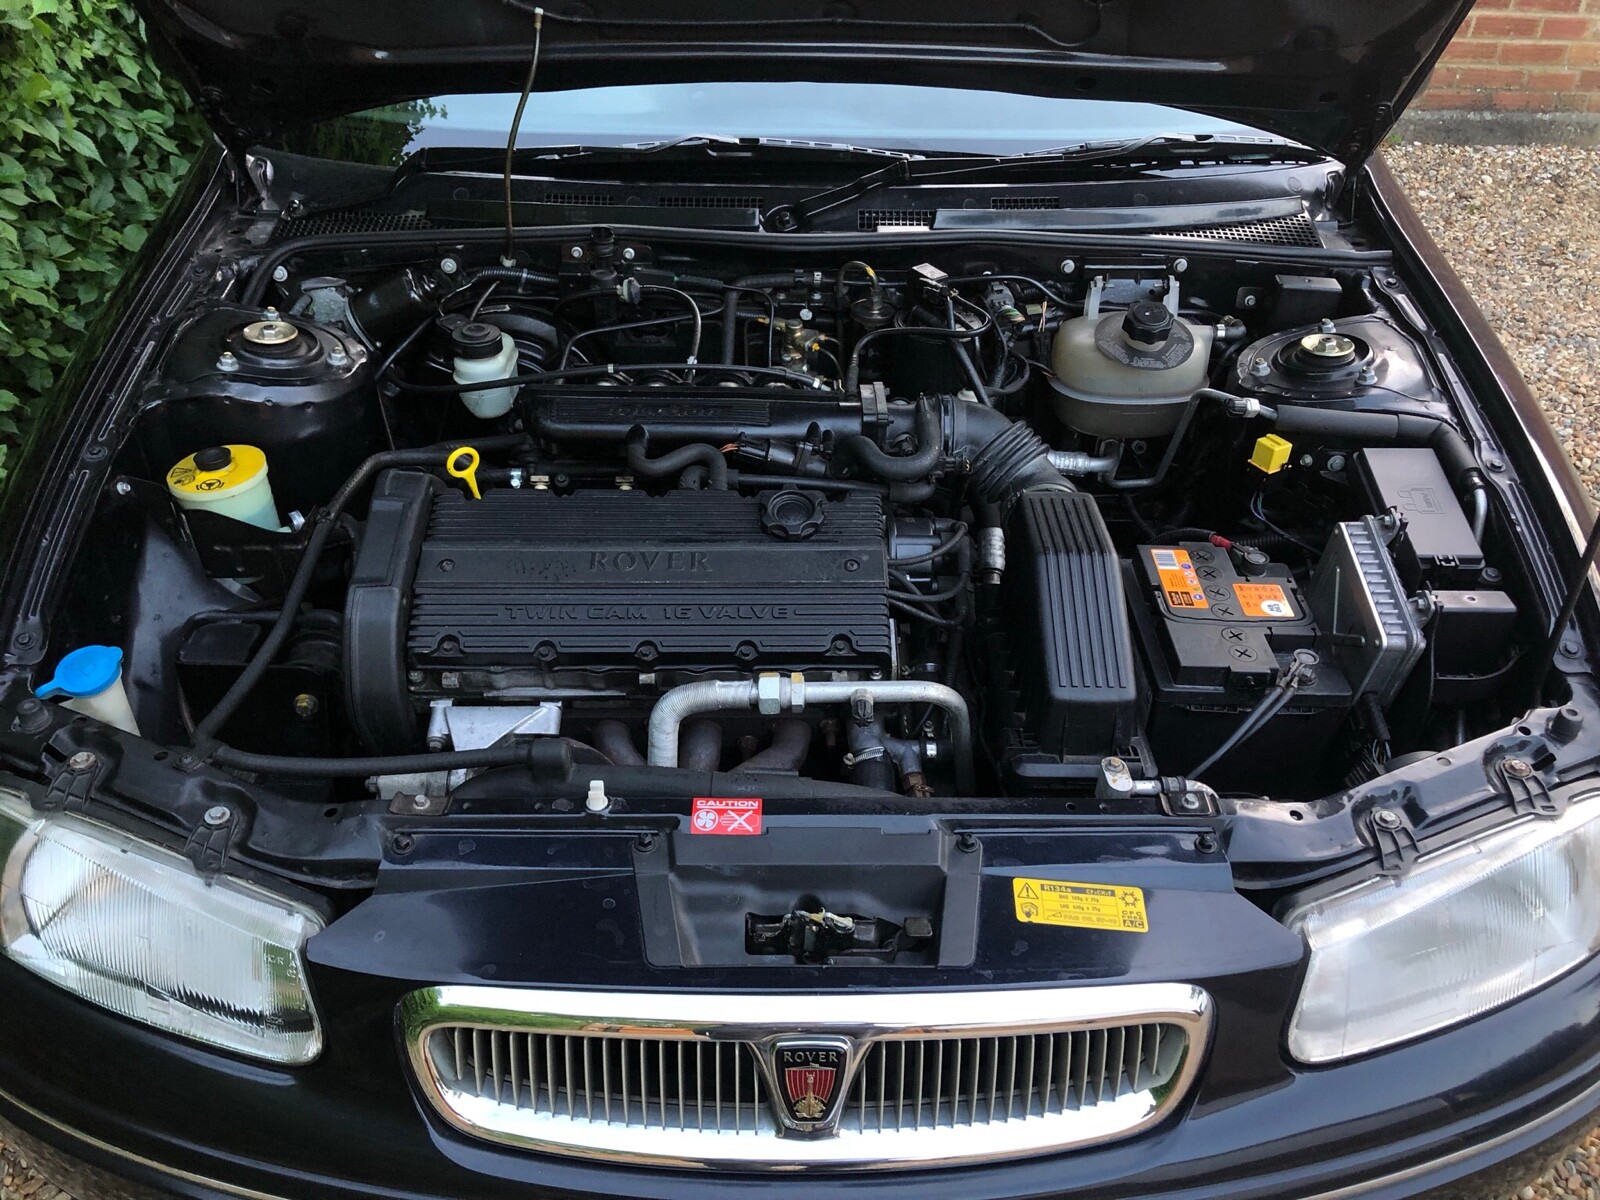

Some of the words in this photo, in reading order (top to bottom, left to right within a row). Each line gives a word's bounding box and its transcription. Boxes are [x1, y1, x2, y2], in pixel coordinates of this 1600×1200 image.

[589, 551, 714, 572] ROVER
[505, 605, 578, 620] TWIN
[587, 605, 648, 620] CAM
[663, 605, 692, 620] 16
[699, 605, 789, 620] VALVE
[1043, 885, 1072, 893] R134a
[1123, 920, 1145, 929] A/C
[783, 1051, 839, 1063] ROVER
